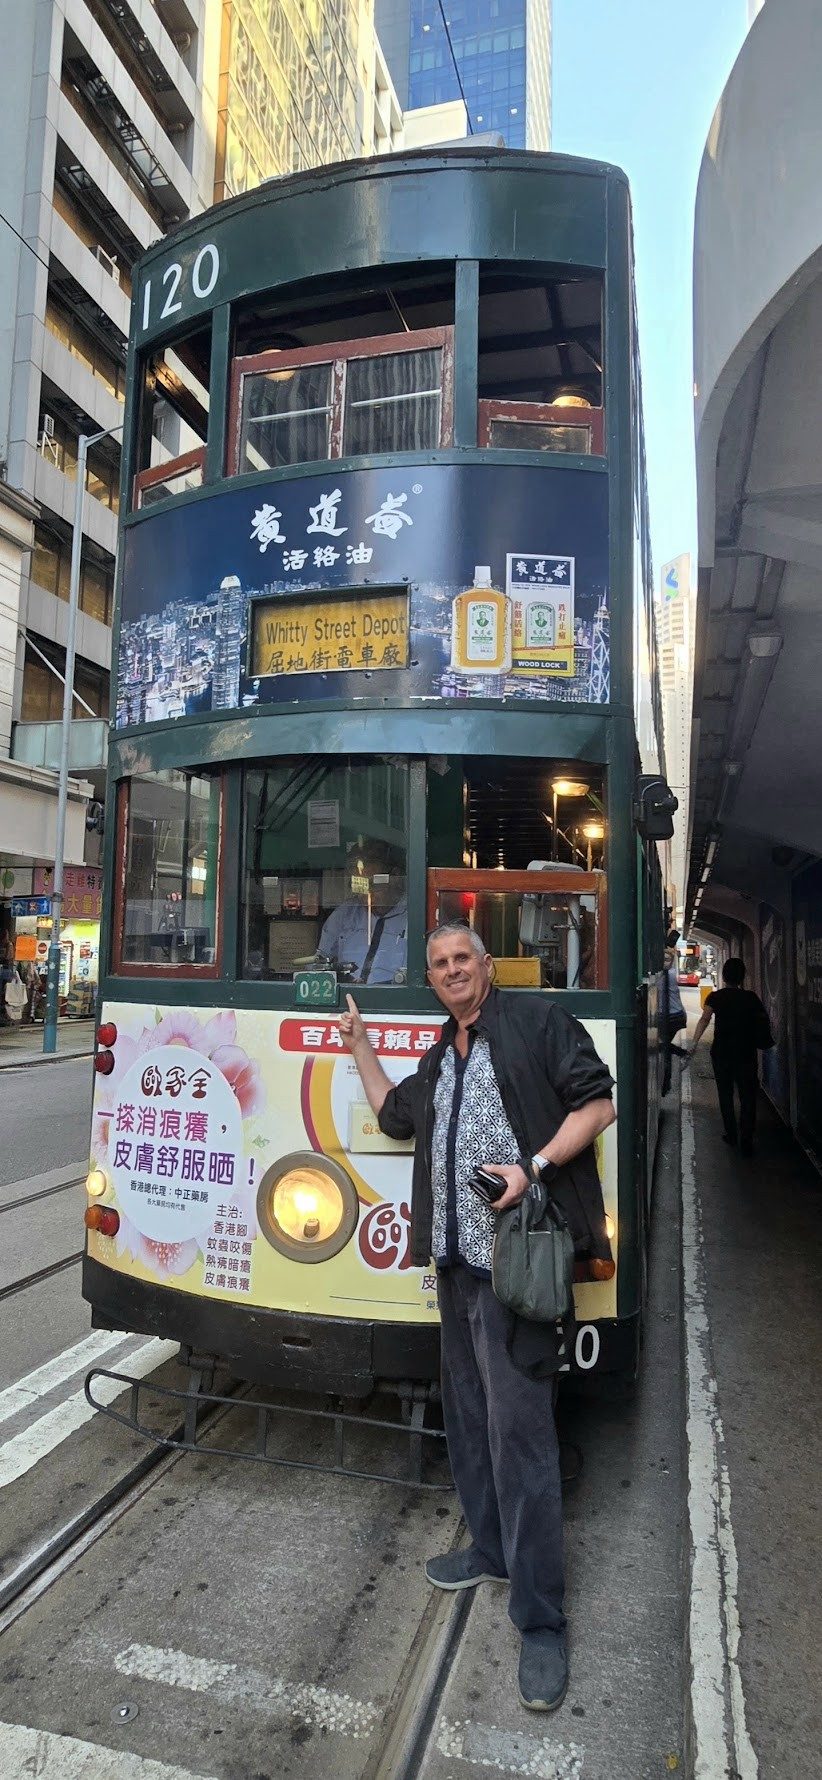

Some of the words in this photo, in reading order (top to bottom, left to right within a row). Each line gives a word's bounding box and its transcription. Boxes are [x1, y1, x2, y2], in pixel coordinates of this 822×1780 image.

[142, 243, 220, 331] 120
[282, 542, 374, 572] 活絡油
[266, 621, 308, 647] Whitty
[314, 616, 356, 642] Street
[362, 613, 405, 639] Depot
[266, 642, 404, 673] 屈地街電車廠
[517, 660, 540, 668] WOOD
[541, 661, 560, 669] LOCK
[299, 979, 333, 998] 022
[213, 1220, 248, 1237] 香港腳
[204, 1271, 250, 1291] 皮膚痕癢
[555, 1317, 600, 1372] 0
